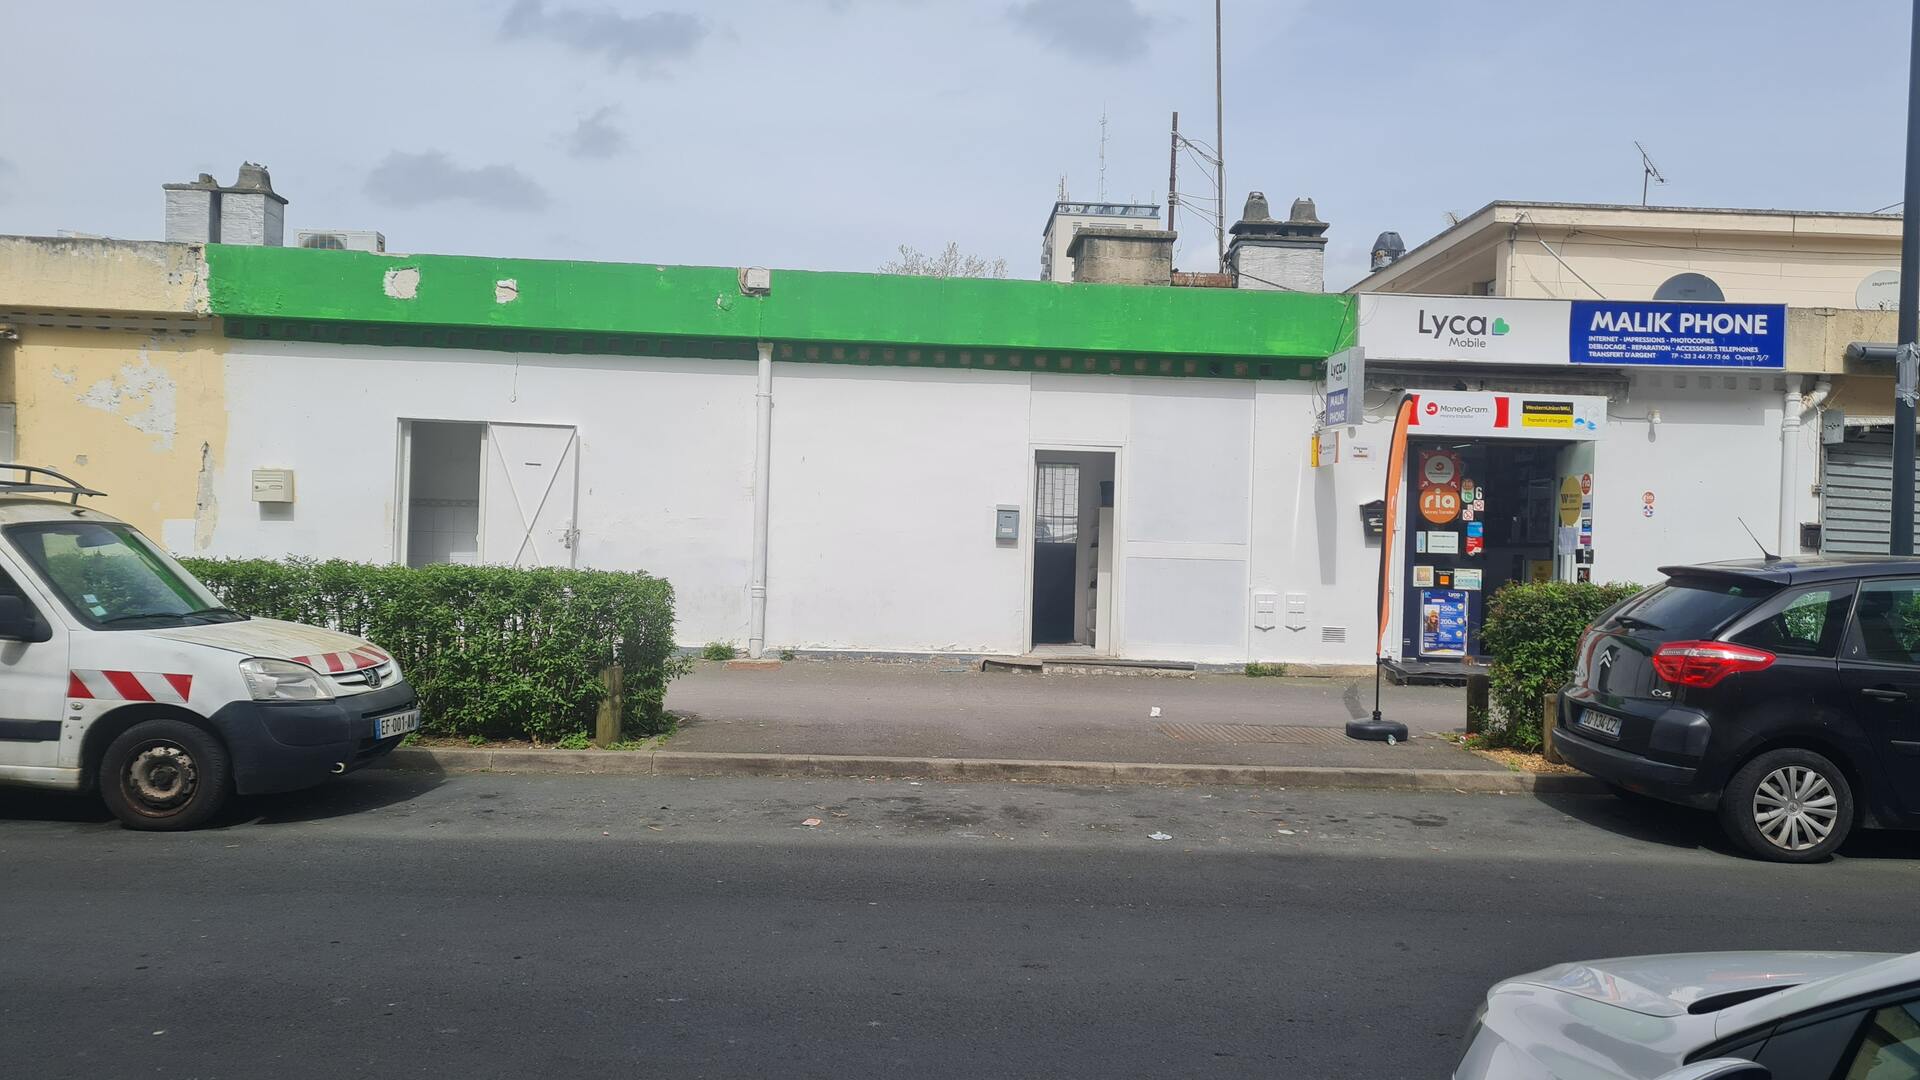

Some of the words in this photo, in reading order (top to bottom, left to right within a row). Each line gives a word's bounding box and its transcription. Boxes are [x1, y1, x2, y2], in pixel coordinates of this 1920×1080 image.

[1418, 309, 1487, 339] Lyca
[1590, 311, 1672, 333] MALIK
[1679, 313, 1768, 335] PHONE
[1449, 337, 1486, 348] Mobile
[1330, 393, 1344, 407] MALIK
[1440, 405, 1488, 414] MoneyGram
[1329, 410, 1345, 424] PHONE
[1425, 488, 1455, 508] ria
[1476, 487, 1482, 499] 6
[1651, 689, 1672, 698] C4
